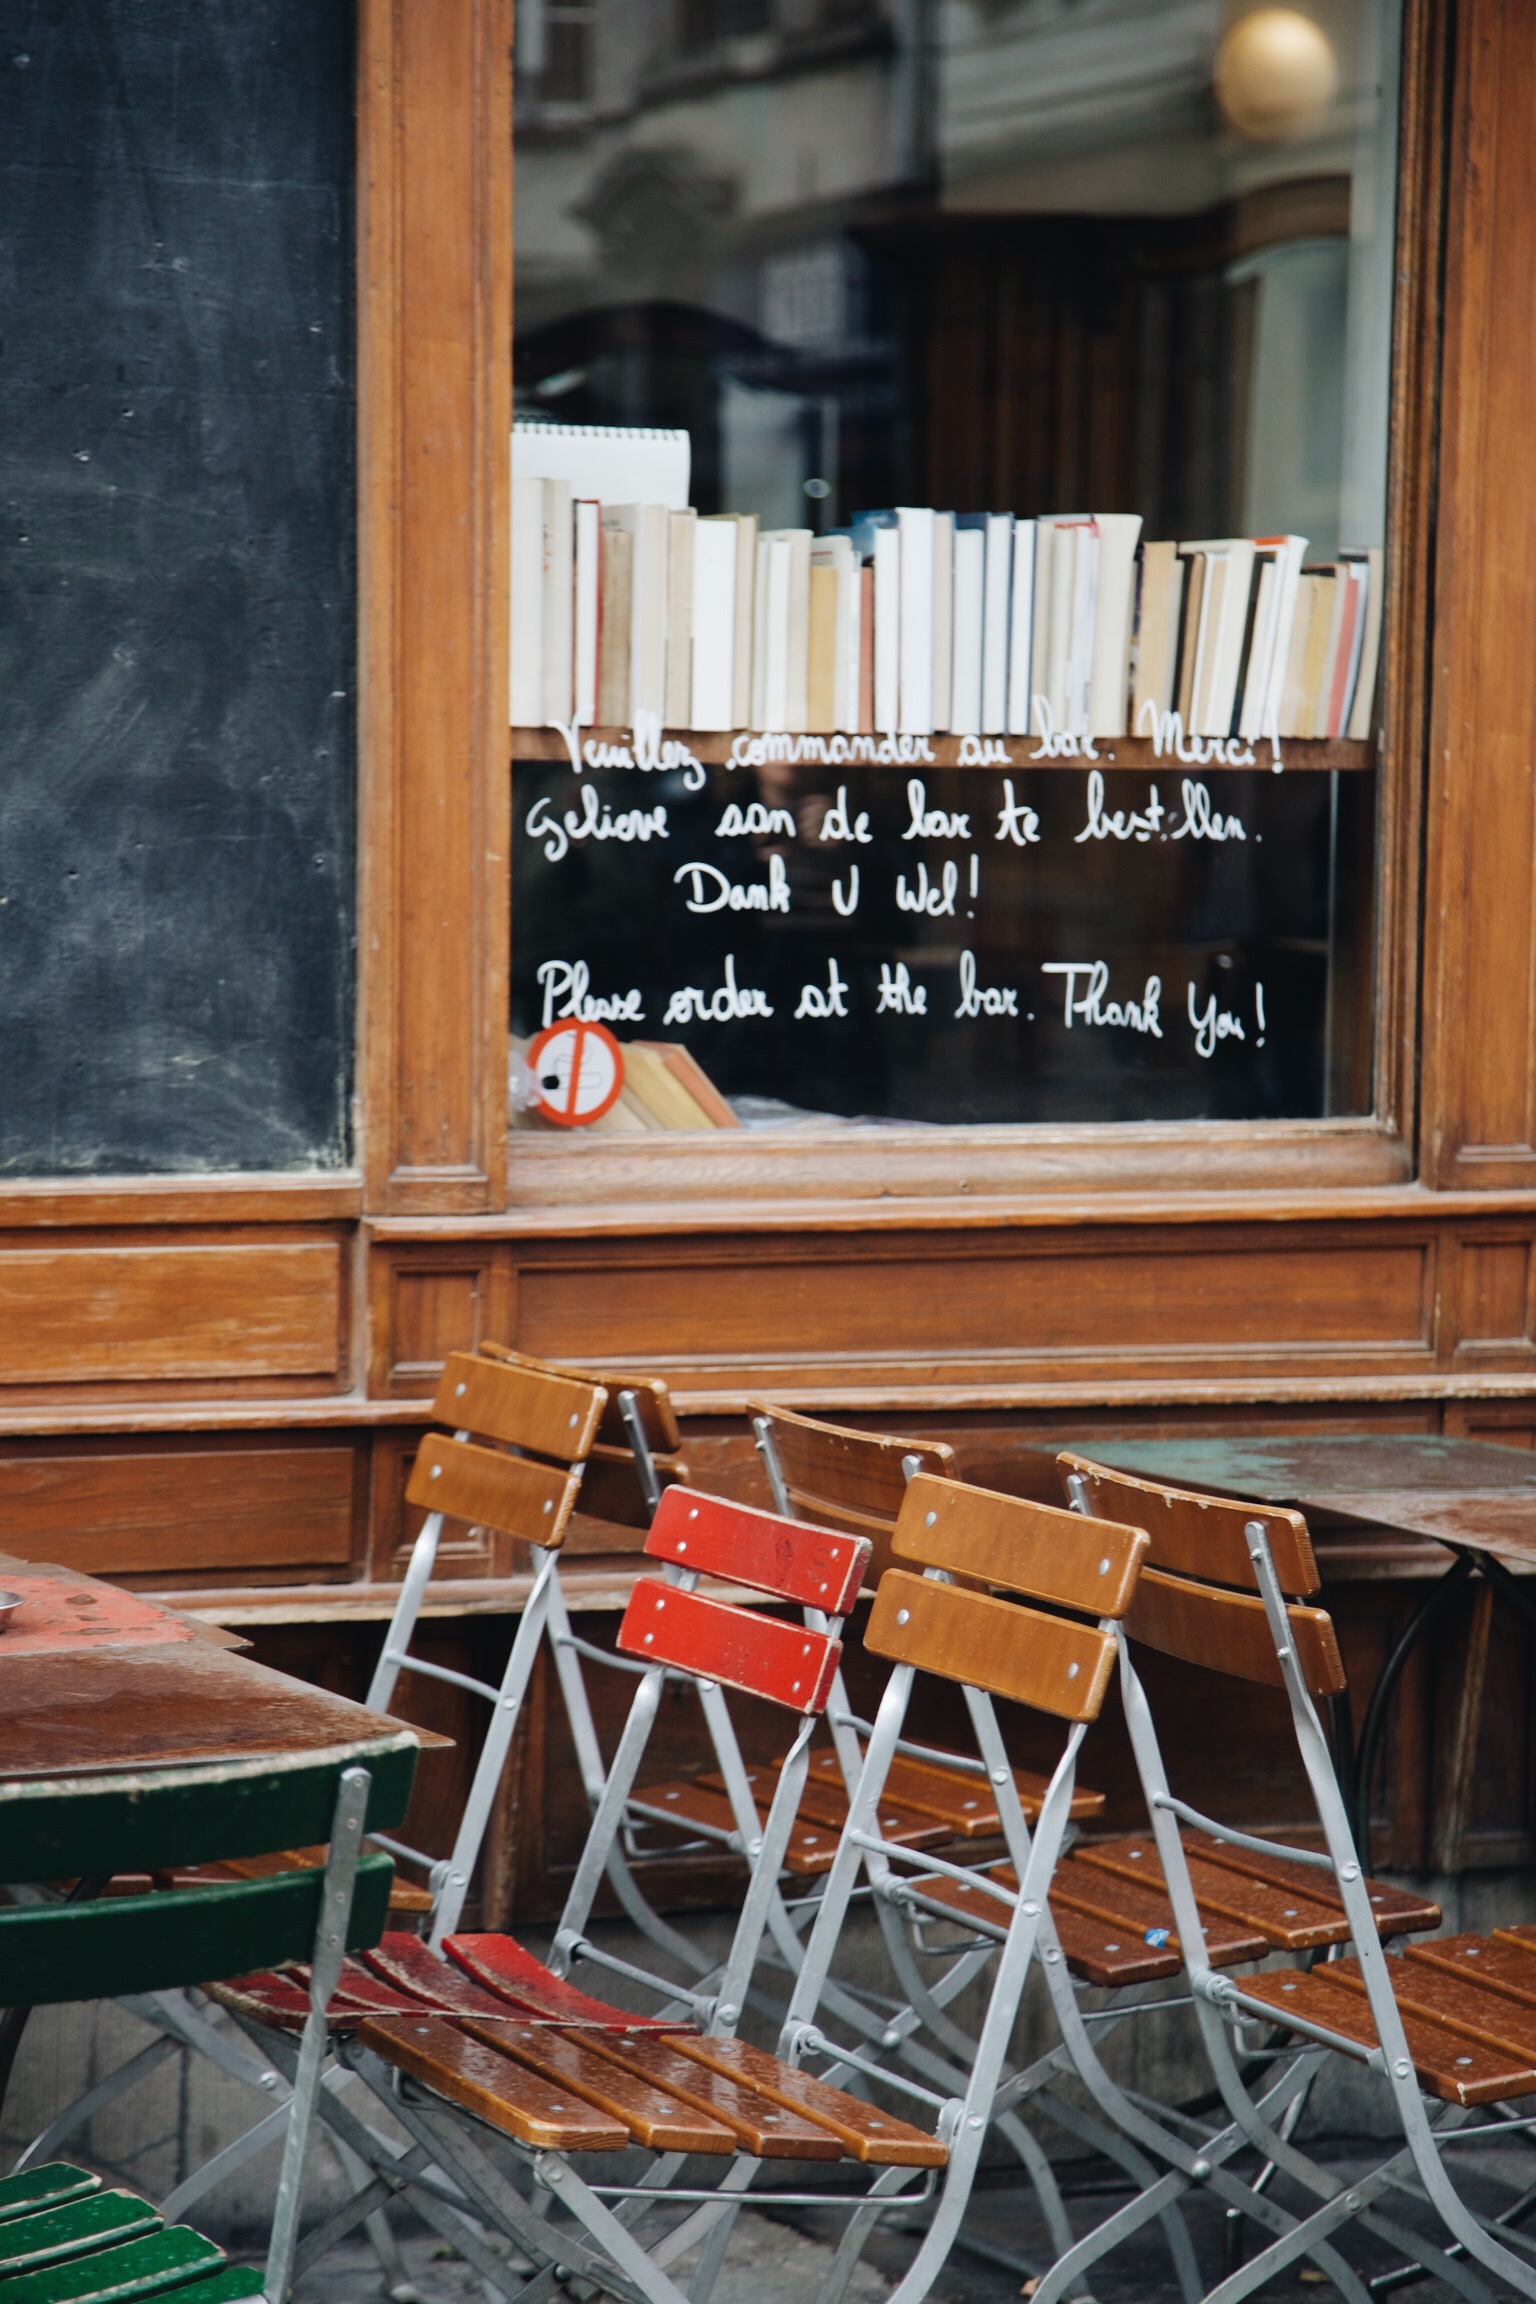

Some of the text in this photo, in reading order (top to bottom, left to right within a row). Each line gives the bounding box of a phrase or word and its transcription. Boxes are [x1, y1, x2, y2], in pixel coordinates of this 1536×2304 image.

[546, 706, 706, 791] Veuillez
[725, 733, 936, 771] commander
[957, 735, 1013, 766] au
[1029, 695, 1115, 761] bar.
[714, 802, 796, 837] aan
[818, 785, 873, 844] de
[901, 778, 972, 840] bar
[995, 778, 1041, 847] te
[673, 853, 791, 913] Dank
[537, 949, 1266, 1058] Please order at the bar. Thank You!
